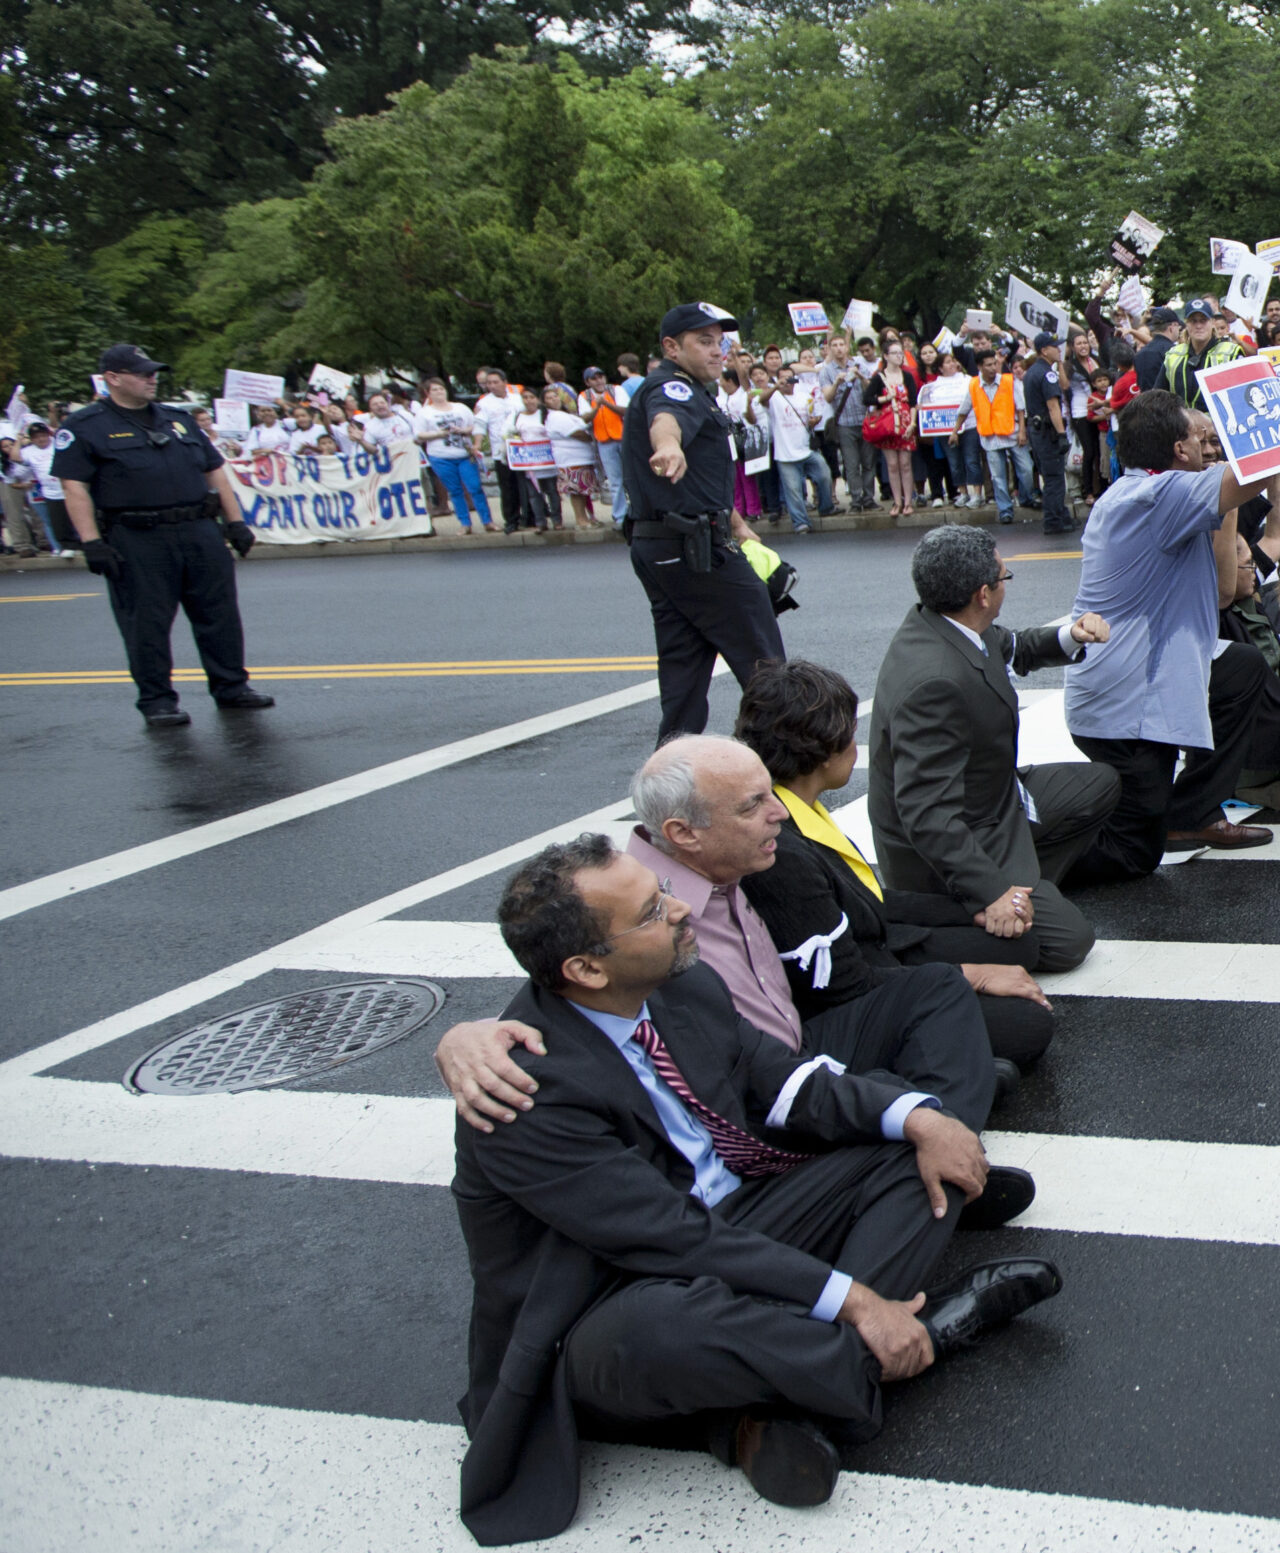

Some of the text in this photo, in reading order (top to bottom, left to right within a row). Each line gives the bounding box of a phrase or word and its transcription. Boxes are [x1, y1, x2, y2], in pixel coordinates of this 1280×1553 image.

[1249, 430, 1267, 451] 11
[337, 446, 393, 480] YOU
[233, 491, 310, 529] WANT
[312, 490, 360, 528] OUR
